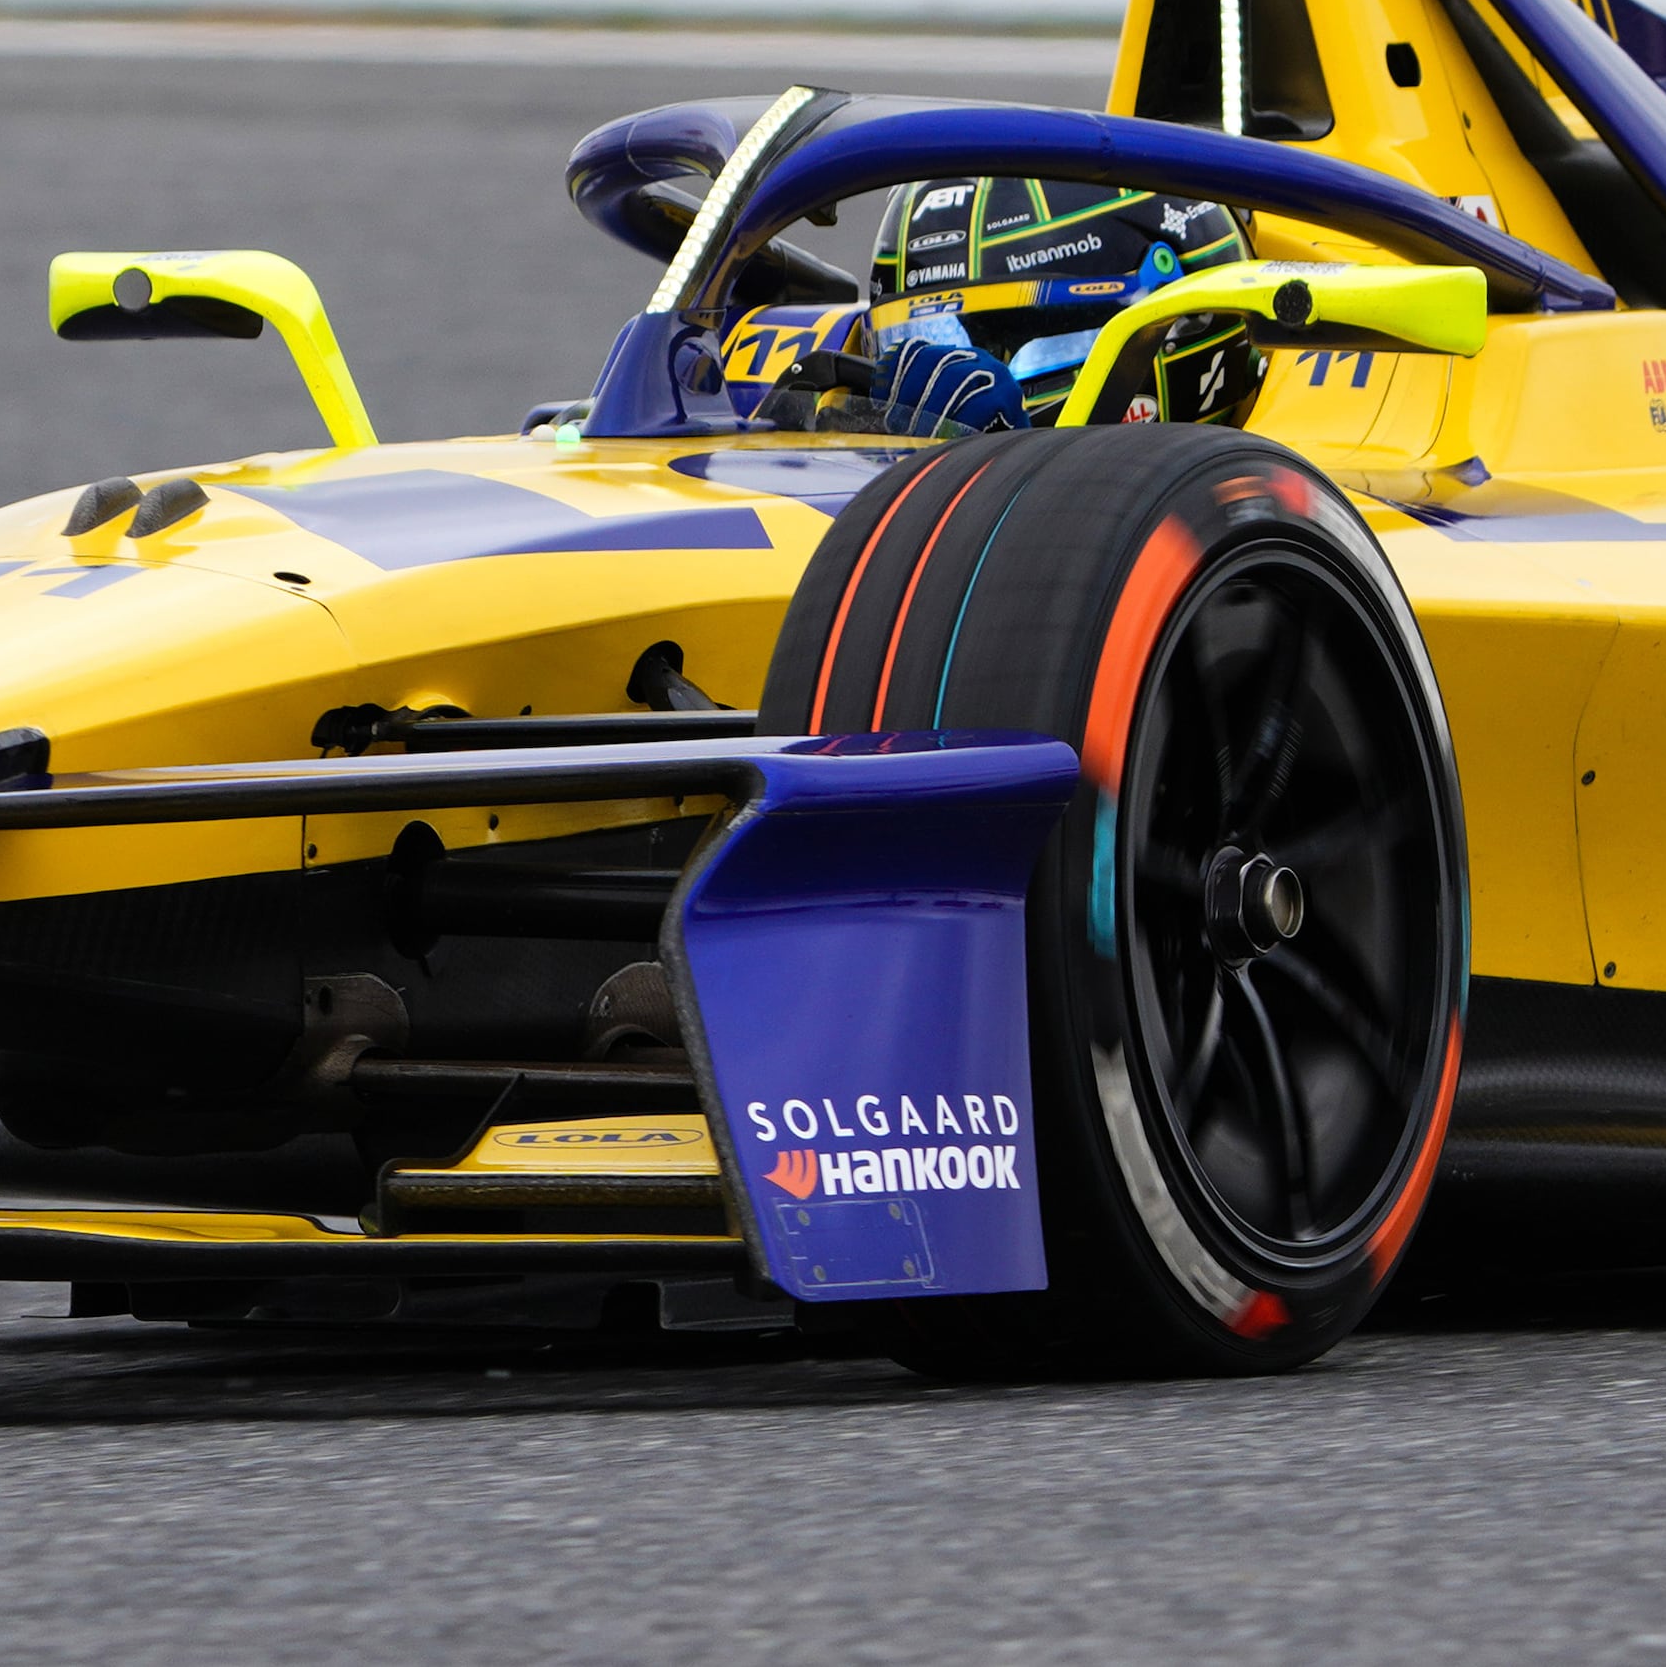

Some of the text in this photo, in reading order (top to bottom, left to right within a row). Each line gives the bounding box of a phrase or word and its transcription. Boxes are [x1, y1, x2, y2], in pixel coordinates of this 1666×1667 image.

[912, 185, 975, 222] ABT
[986, 213, 1031, 231] SOLGAARD
[911, 233, 960, 249] LOLA
[1006, 233, 1103, 273] ituranmob
[919, 262, 966, 284] YAMAHA
[908, 291, 964, 307] LOLA
[1296, 349, 1375, 388] 11
[747, 1094, 1020, 1142] SOLGAARD
[516, 1133, 681, 1144] LOLA
